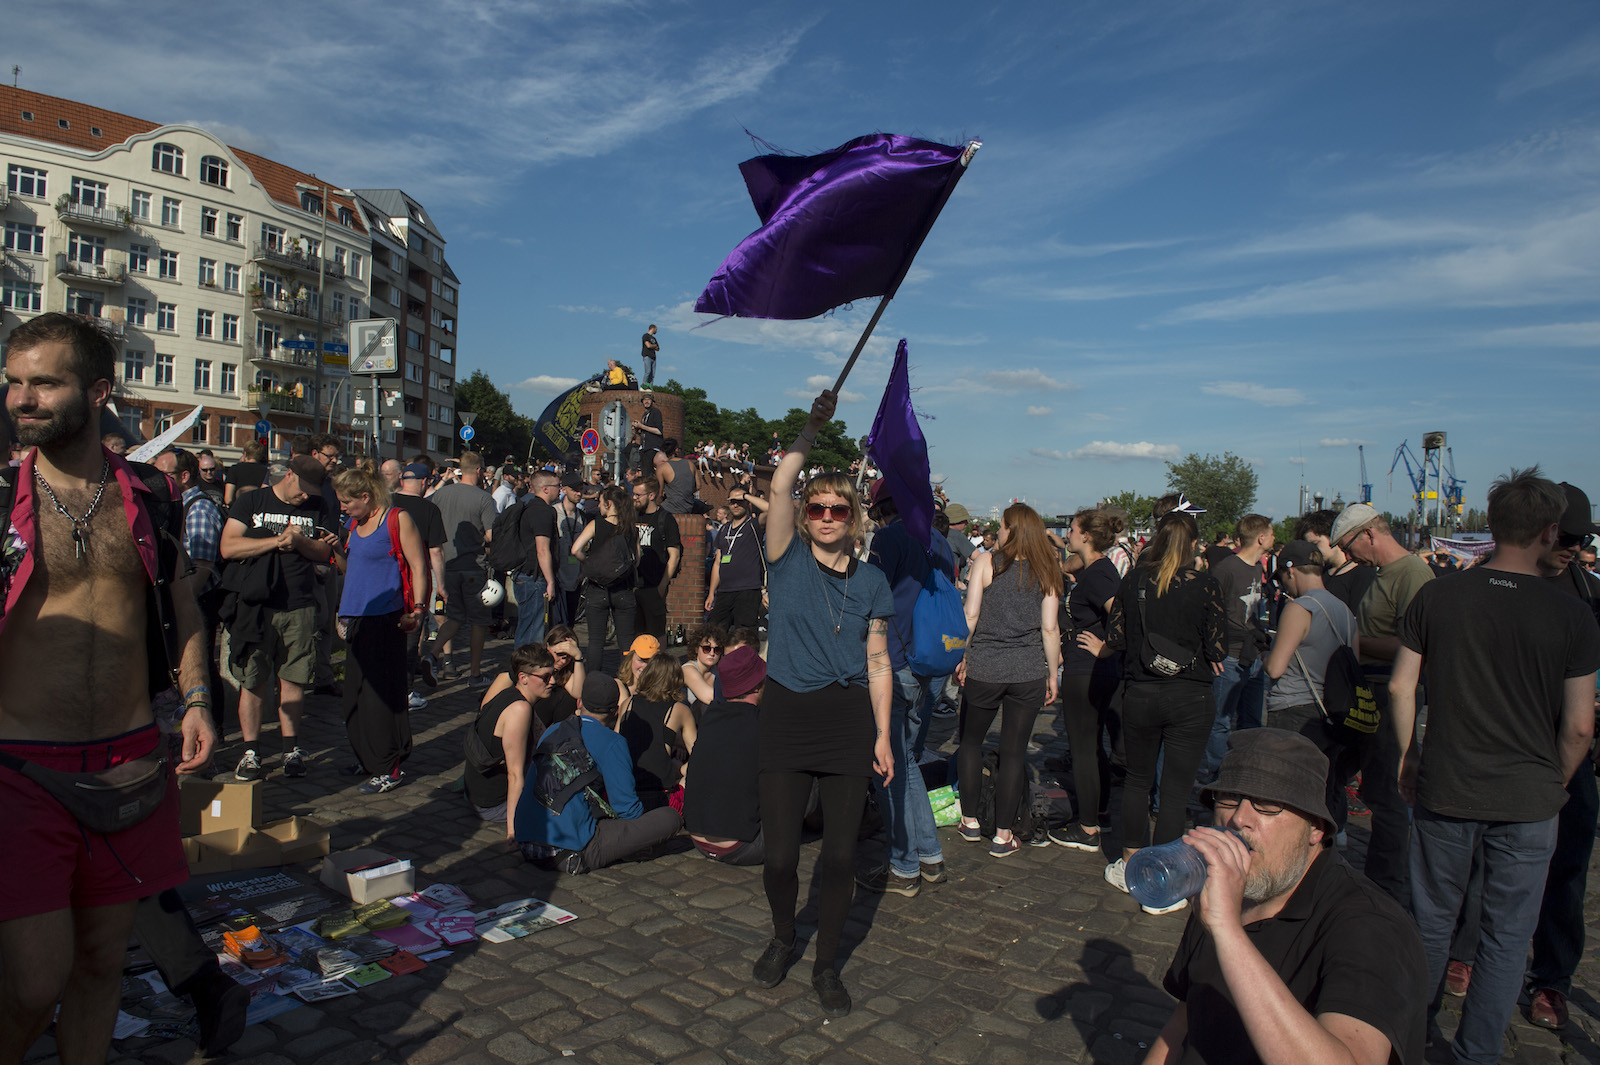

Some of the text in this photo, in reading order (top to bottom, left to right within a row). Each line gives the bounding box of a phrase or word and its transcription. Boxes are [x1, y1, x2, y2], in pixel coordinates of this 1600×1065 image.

[361, 360, 385, 369] ZNE
[264, 513, 314, 527] RUDE BOYS
[206, 872, 287, 893] Widerstand
